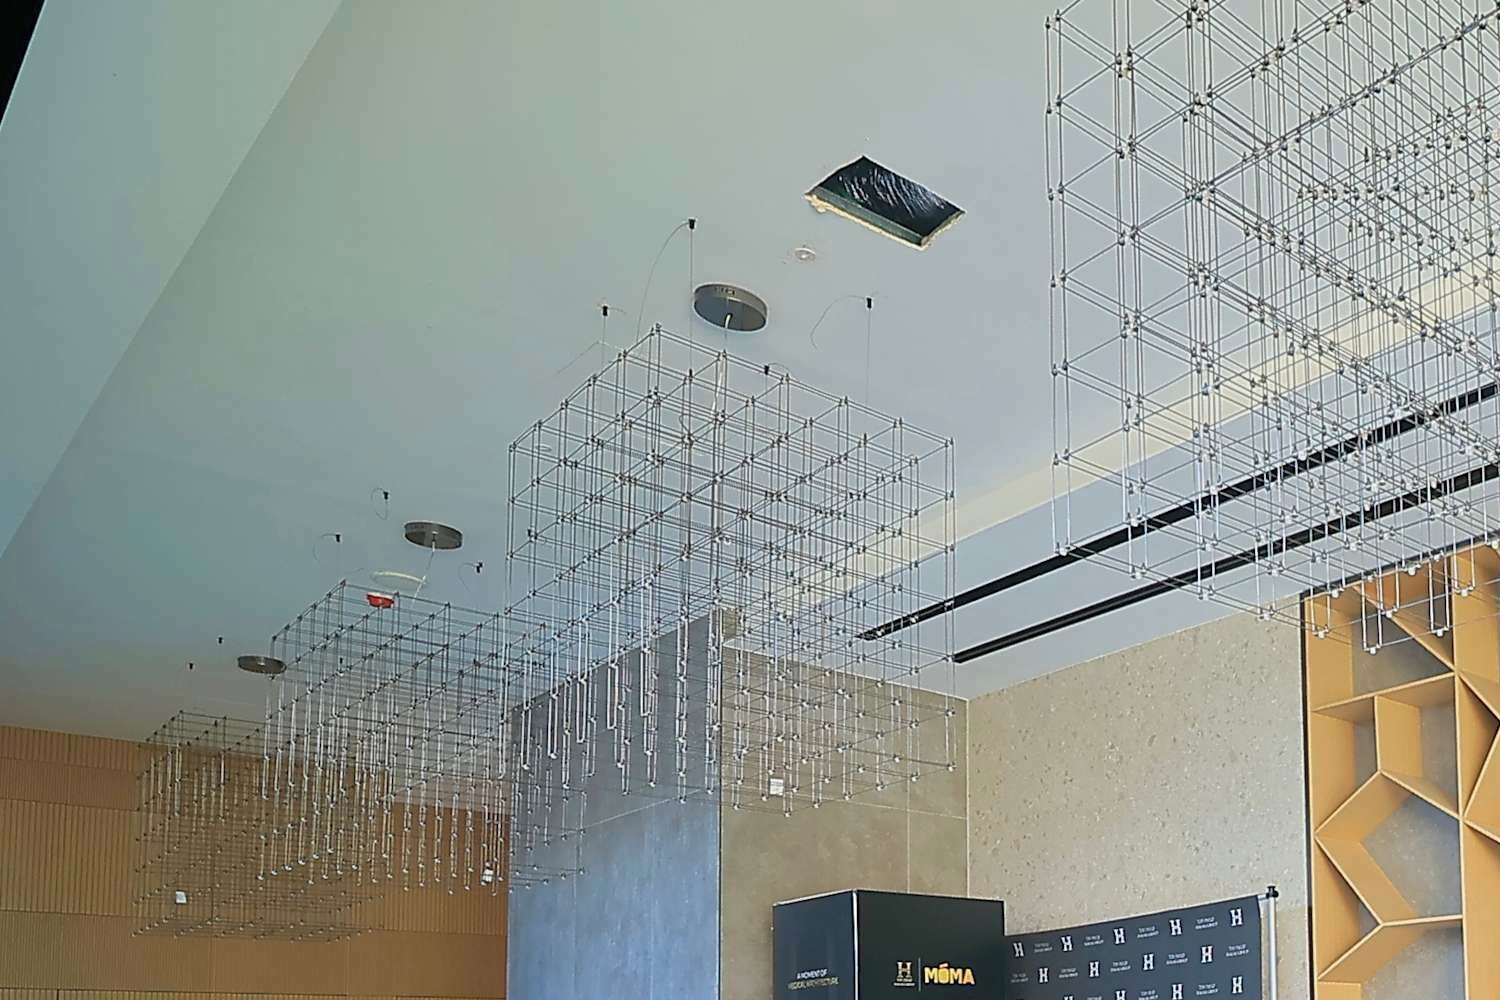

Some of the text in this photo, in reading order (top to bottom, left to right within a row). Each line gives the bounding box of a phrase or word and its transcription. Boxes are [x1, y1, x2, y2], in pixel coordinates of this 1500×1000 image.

[1230, 909, 1242, 926] H
[1169, 919, 1181, 935] H
[1061, 936, 1072, 951] H
[1113, 928, 1124, 944] H
[1013, 943, 1023, 956] H
[1201, 946, 1212, 963] H
[1089, 962, 1099, 977] H
[1143, 954, 1153, 970] H
[1038, 968, 1048, 982] H
[1172, 984, 1182, 1000] H
[1232, 977, 1242, 993] H
